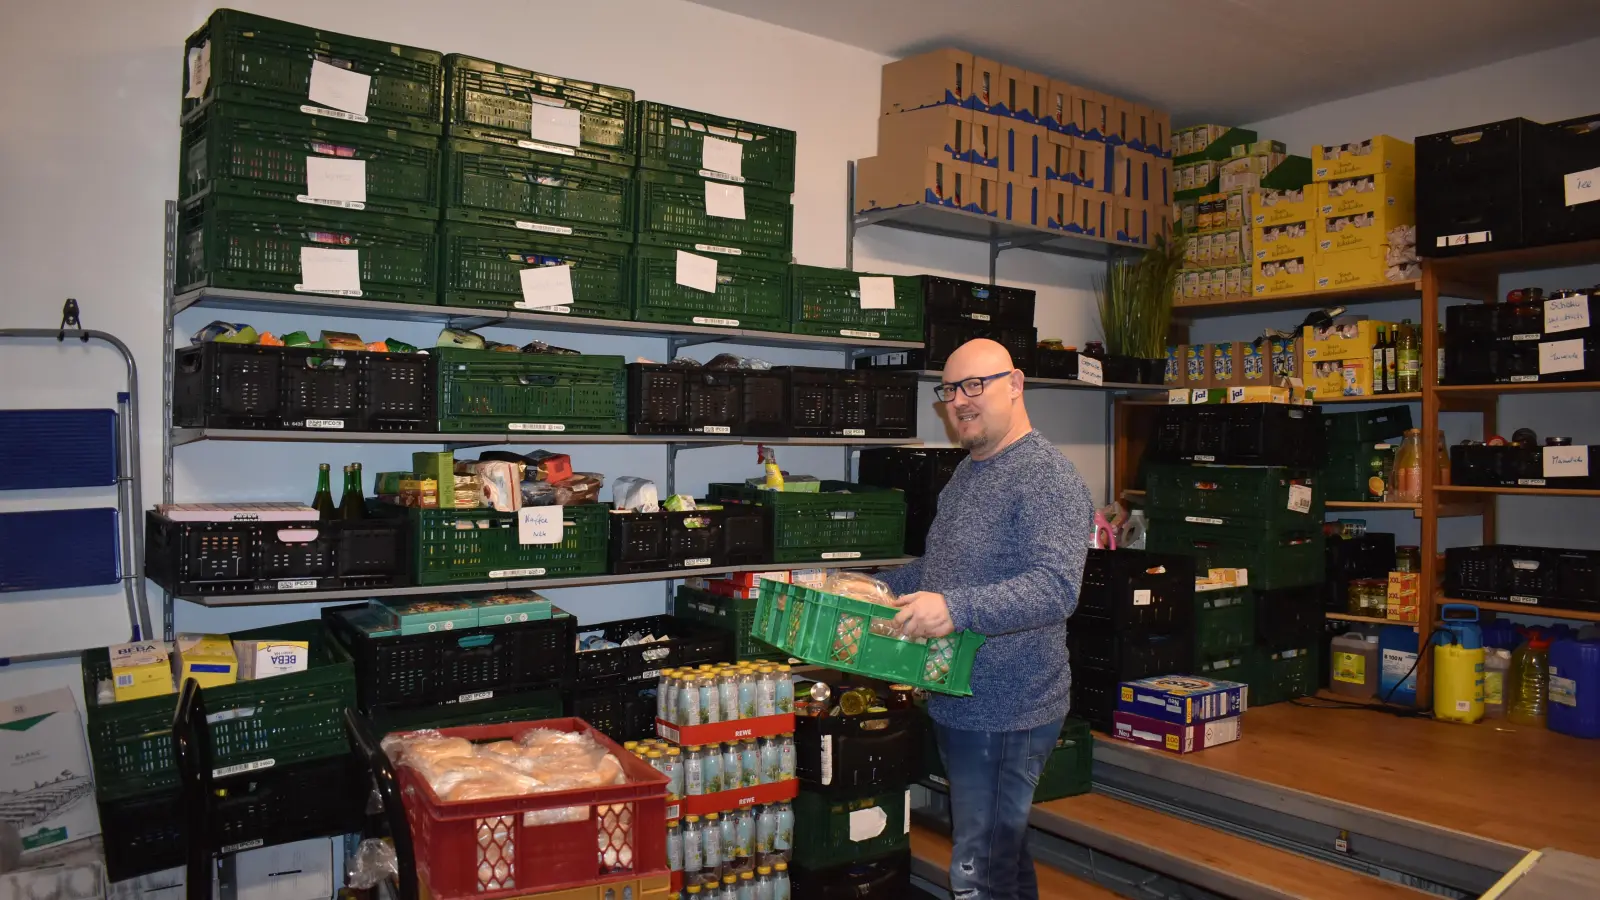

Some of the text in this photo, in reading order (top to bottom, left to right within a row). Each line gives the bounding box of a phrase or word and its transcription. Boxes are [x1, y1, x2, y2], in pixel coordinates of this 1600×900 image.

[1195, 390, 1206, 402] ja!
[1232, 388, 1243, 401] ja!
[118, 644, 157, 655] BEBA
[271, 655, 297, 664] BEBA
[1168, 698, 1180, 707] Neu
[735, 729, 752, 737] REWE
[1118, 728, 1130, 738] Neu
[738, 796, 755, 804] REWE
